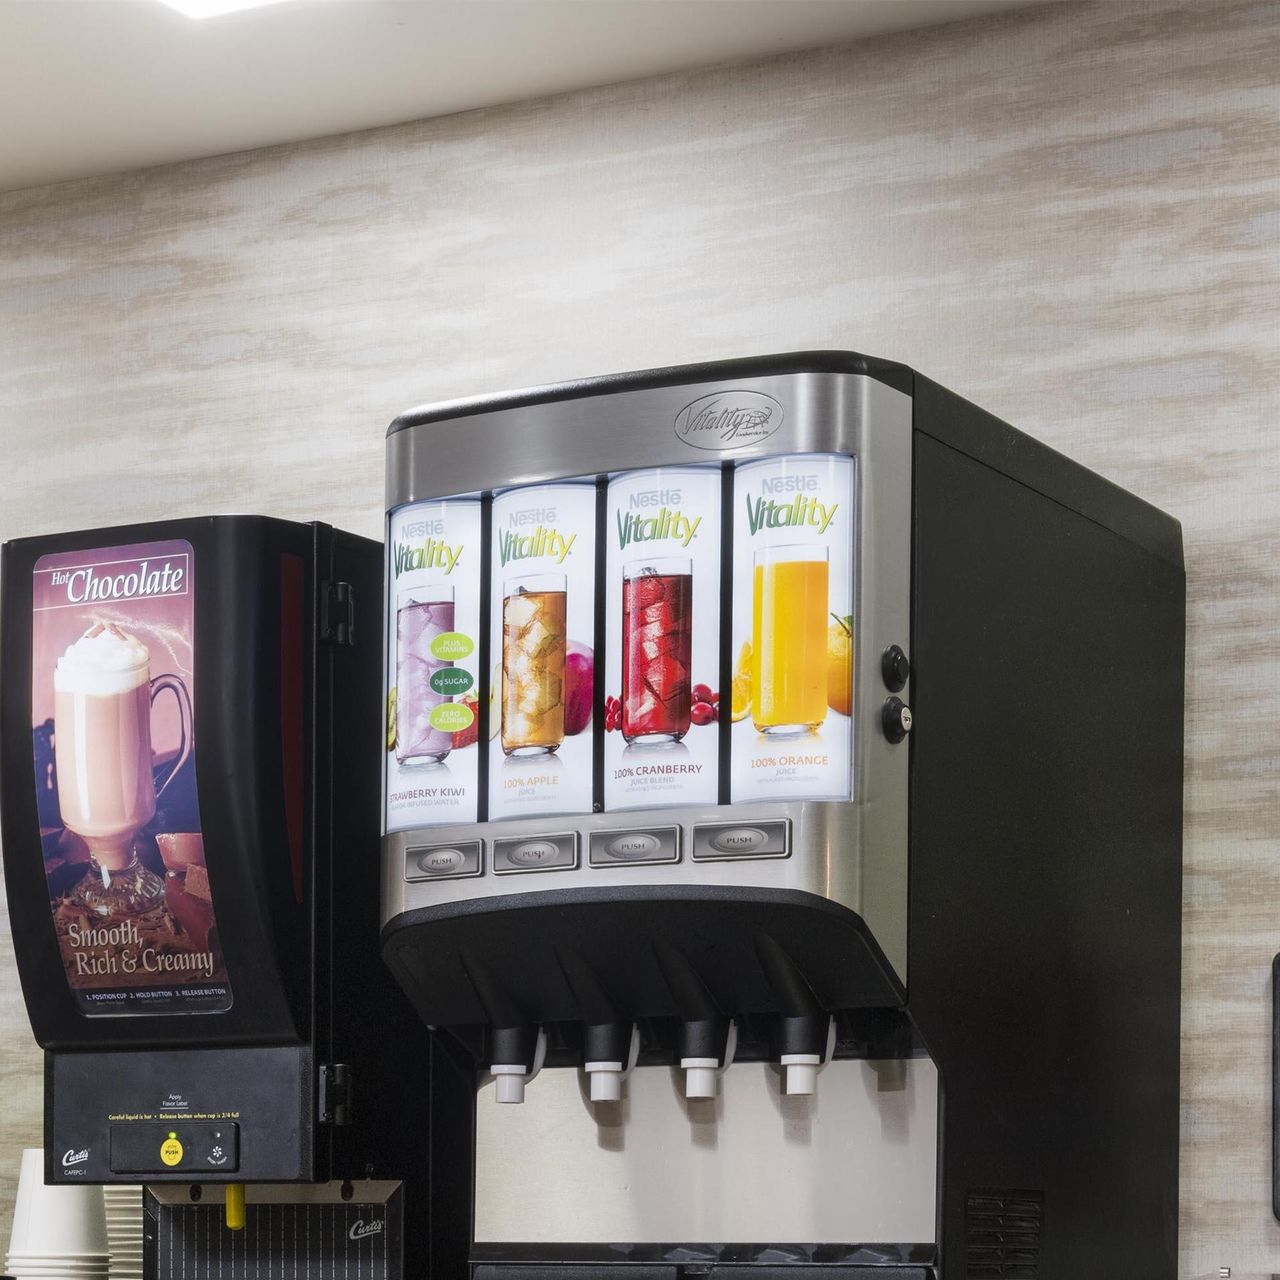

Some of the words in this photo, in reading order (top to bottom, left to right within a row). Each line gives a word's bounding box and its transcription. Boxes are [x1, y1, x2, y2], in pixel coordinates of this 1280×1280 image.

[681, 398, 745, 441] Vitality
[746, 493, 839, 537] Vitality
[616, 507, 702, 550] Vitality
[498, 525, 577, 569] Vitality
[393, 537, 464, 580] Vitality
[51, 571, 70, 586] Hot
[67, 560, 184, 603] Chocolate
[443, 678, 469, 686] SUGAR
[750, 757, 777, 769] 100%
[778, 755, 829, 766] ORANGE
[614, 767, 634, 780] 100%
[635, 764, 703, 776] CRANBERRY
[503, 778, 525, 789] 100%
[526, 775, 559, 786] APPLE
[389, 788, 438, 804] STRAWBERRY
[440, 787, 466, 797] KIWI
[621, 841, 646, 851] PUSH
[726, 835, 753, 845] PUSH
[431, 857, 453, 866] PUSH
[522, 849, 545, 859] PUSH
[68, 920, 144, 948] Smooth,
[74, 950, 118, 976] Rich
[122, 950, 137, 973] &
[142, 948, 214, 977] Creamy
[92, 993, 117, 1001] POSITION
[116, 992, 127, 1000] CUP
[181, 989, 205, 997] RELEASE
[204, 988, 226, 996] BUTTON
[62, 1149, 89, 1167] Curtis
[349, 1219, 384, 1240] Curtis
